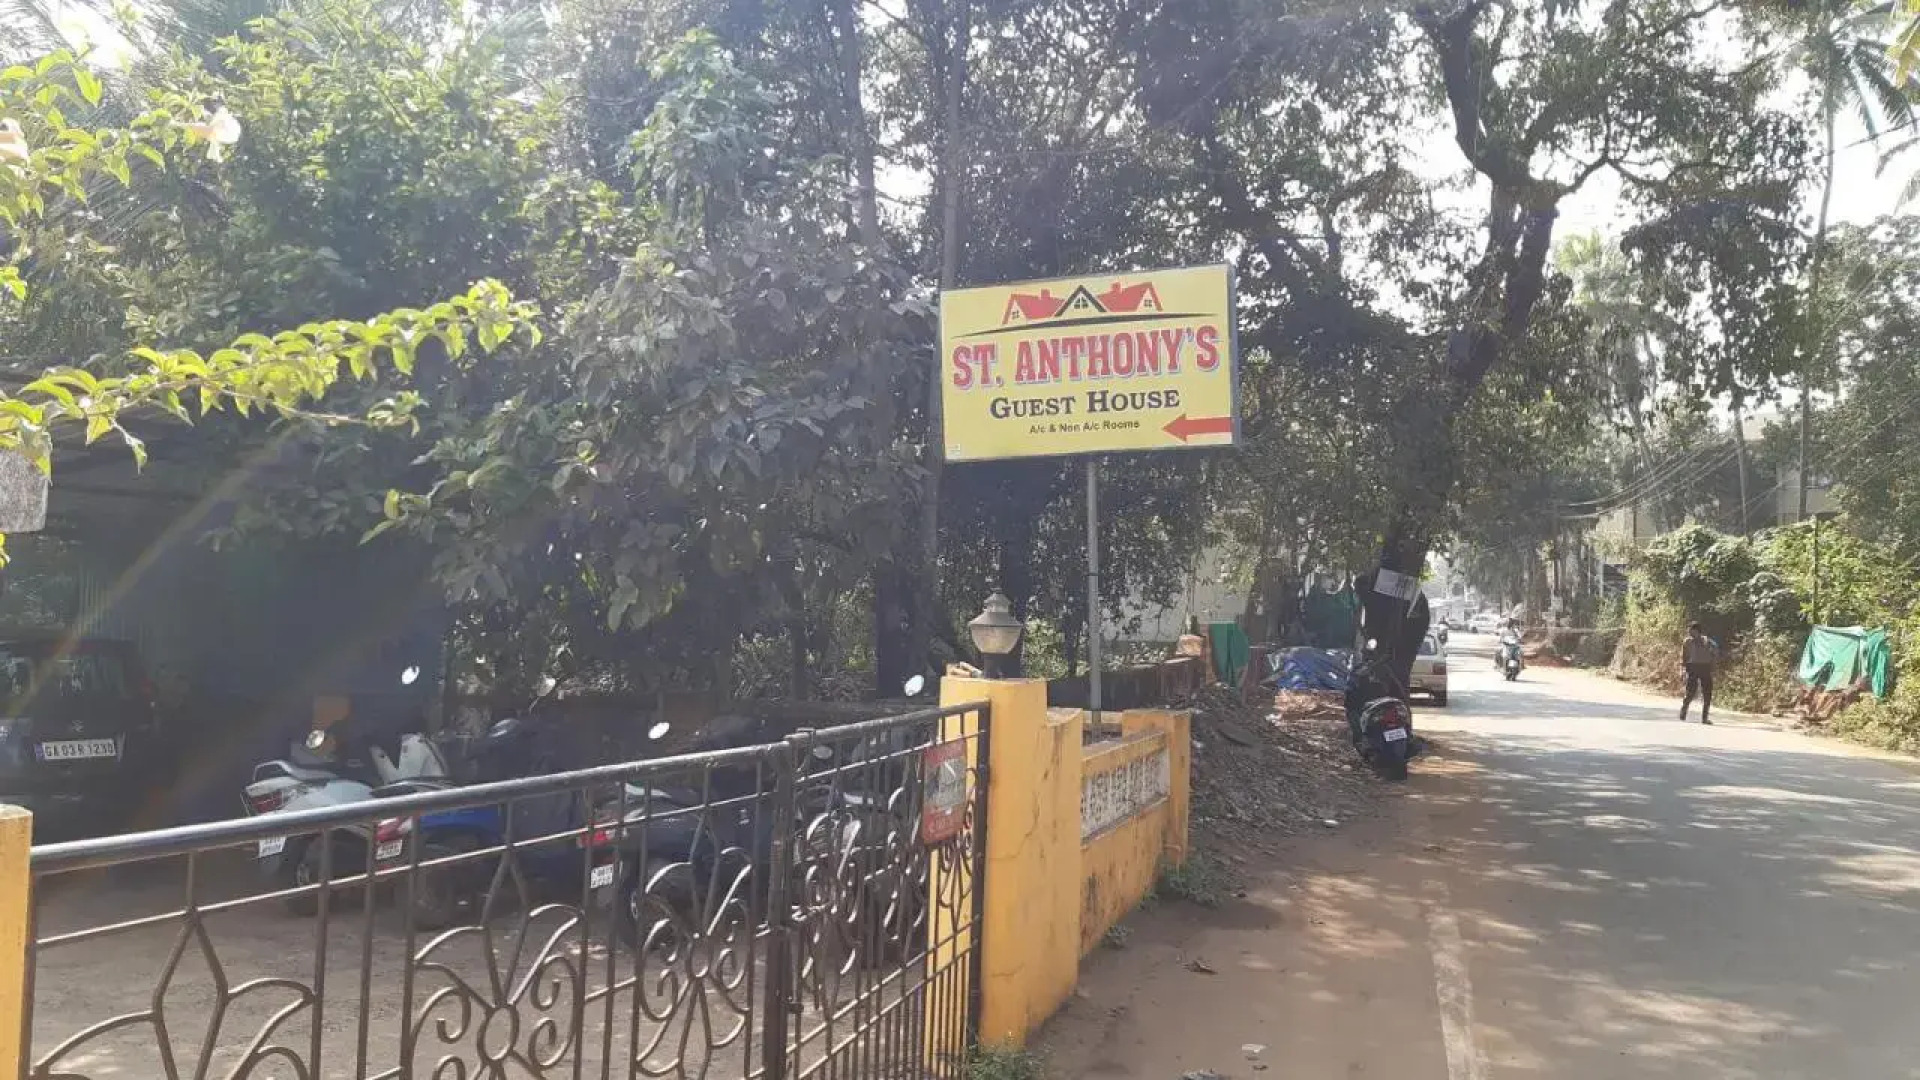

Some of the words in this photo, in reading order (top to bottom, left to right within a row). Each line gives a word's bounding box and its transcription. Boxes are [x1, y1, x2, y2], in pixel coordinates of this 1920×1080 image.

[953, 344, 1004, 389] ST.
[1015, 325, 1220, 385] ANTHONY'S
[1049, 424, 1057, 433] &
[1059, 423, 1080, 433] Non
[1103, 420, 1140, 430] Rooms
